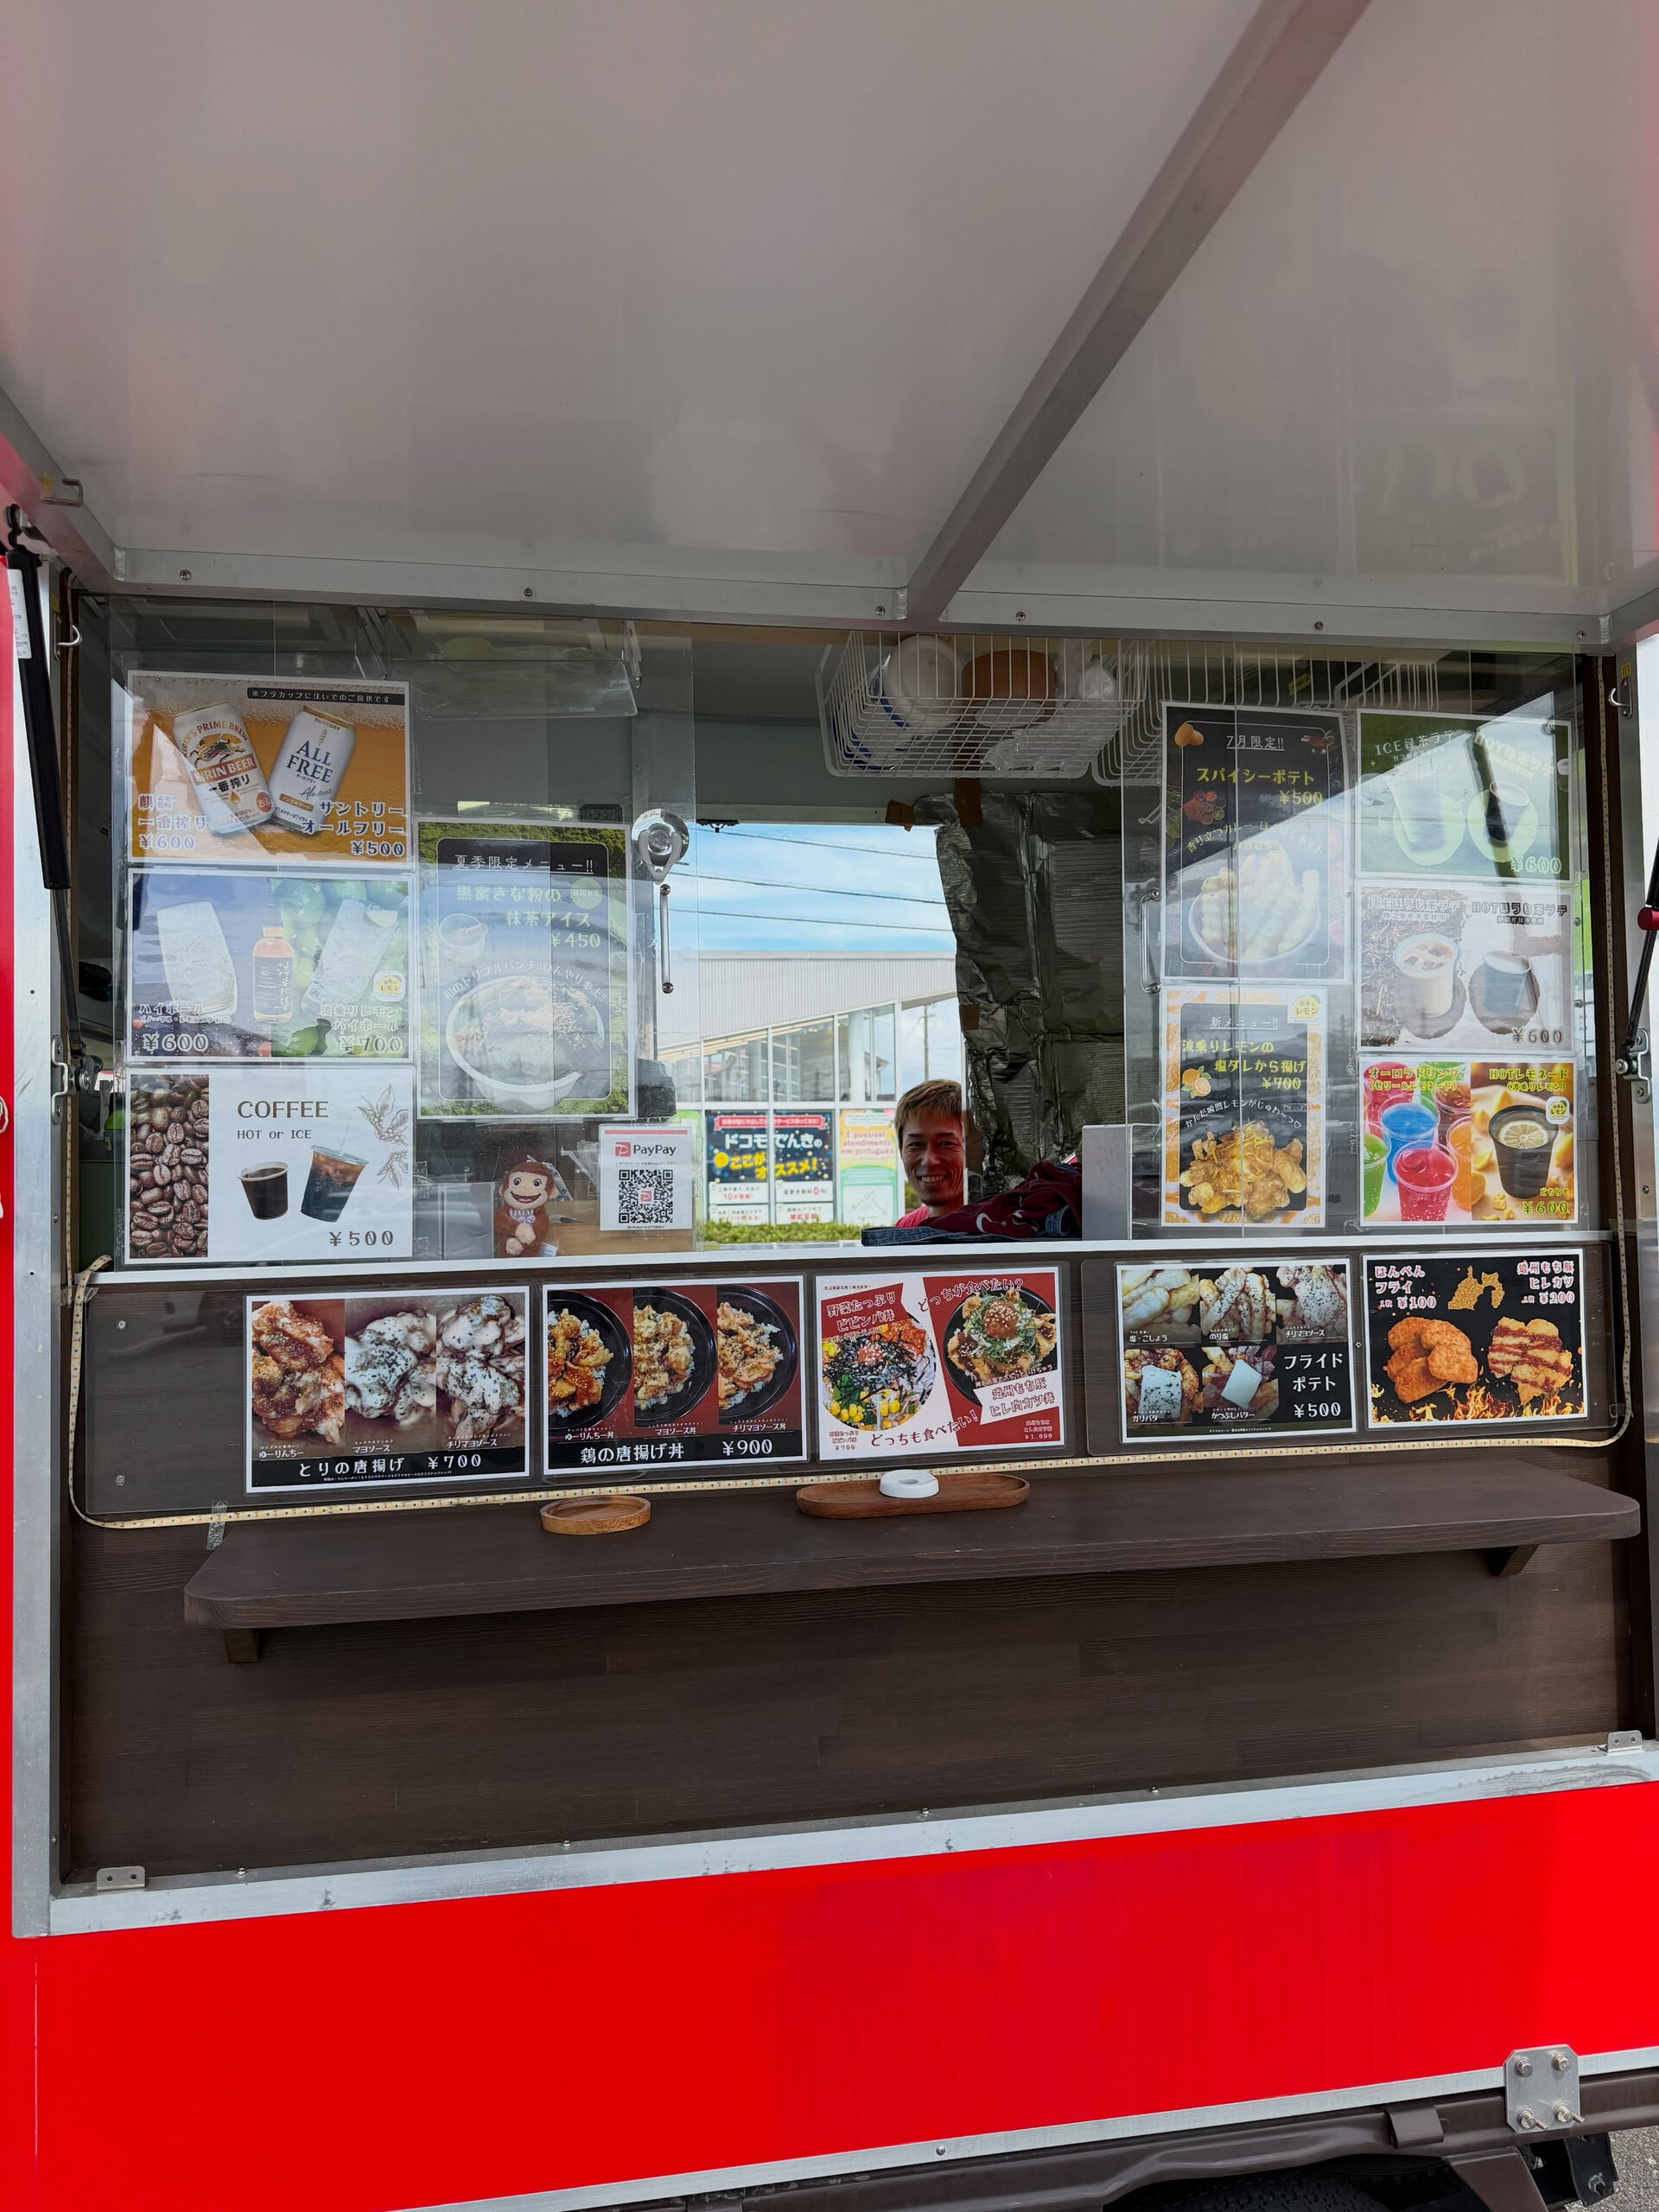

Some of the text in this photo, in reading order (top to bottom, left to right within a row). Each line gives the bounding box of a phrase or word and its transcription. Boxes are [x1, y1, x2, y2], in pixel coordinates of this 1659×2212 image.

[196, 720, 226, 734] PRIME
[229, 721, 249, 741] BREW
[315, 717, 340, 731] SUNTORY
[296, 740, 332, 766] ALL
[227, 756, 255, 775] BEER
[286, 753, 334, 784] FREE
[208, 773, 251, 793] 一番搾り
[1197, 768, 1314, 785] スパイシーポテト
[1279, 790, 1323, 805] ¥500
[320, 802, 403, 817] サントリー
[139, 815, 206, 830] 一番搾り
[302, 820, 403, 836] オールフリー
[140, 835, 195, 849] ¥600
[353, 842, 404, 855] ¥500
[1511, 856, 1561, 874] ¥600
[457, 886, 561, 902] 黒蜜きな粉の
[506, 911, 591, 928] 抹茶アイス
[550, 932, 601, 948] ¥450
[138, 1002, 204, 1016] ハイボール
[1295, 1007, 1319, 1016] レモン
[334, 1019, 398, 1032] ハイボール
[143, 1033, 208, 1052] ¥600
[1514, 1028, 1562, 1043] ¥600
[339, 1035, 403, 1053] ¥700
[1182, 1039, 1274, 1054] 波乗りレモンの
[1215, 1059, 1307, 1074] 塩ダレから揚げ
[1370, 1068, 1459, 1079] オーロラドリンク
[1489, 1068, 1569, 1080] HOTレモネード
[1262, 1077, 1301, 1090] ¥700
[237, 1100, 328, 1118] COFFEE
[237, 1129, 262, 1139] HOT
[290, 1129, 312, 1139] ICE
[633, 1145, 677, 1155] PayPay
[843, 1139, 893, 1147] atendimento
[729, 1151, 767, 1171] ここが
[754, 1159, 817, 1181] オススメ!
[1540, 1187, 1570, 1197] どちらも
[1522, 1201, 1568, 1215] ¥600
[329, 1230, 394, 1247] ¥500
[1516, 1260, 1575, 1275] 遠州もち豚
[1376, 1281, 1413, 1294] フライ
[1529, 1275, 1574, 1290] ヒレカツ
[827, 1291, 896, 1318] 野菜たっぷり
[1397, 1296, 1437, 1310] ¥100
[1539, 1292, 1575, 1305] ¥200
[836, 1309, 895, 1332] ビビンバ丼
[1285, 1329, 1325, 1338] チリマヨソース
[1284, 1353, 1343, 1370] フライド
[992, 1376, 1048, 1401] 遠州もち豚
[1293, 1376, 1336, 1392] ポテト
[989, 1391, 1055, 1418] ヒレ肉カツ丼
[1294, 1402, 1341, 1418] ¥500
[1132, 1414, 1158, 1423] ガリバタ
[1211, 1411, 1255, 1420] かつぶしバター
[655, 1427, 696, 1435] マヨソース丼
[733, 1422, 786, 1433] チリマヨソース丼
[564, 1431, 615, 1440] ゆーりんちー丼
[353, 1444, 391, 1453] マヨソース
[447, 1439, 498, 1449] チリマヨソース
[259, 1449, 304, 1459] ゆーりんちー
[580, 1439, 772, 1465] 鶏の唐揚げ丼 ¥900
[299, 1453, 481, 1478] とりの唐揚げ ¥700
